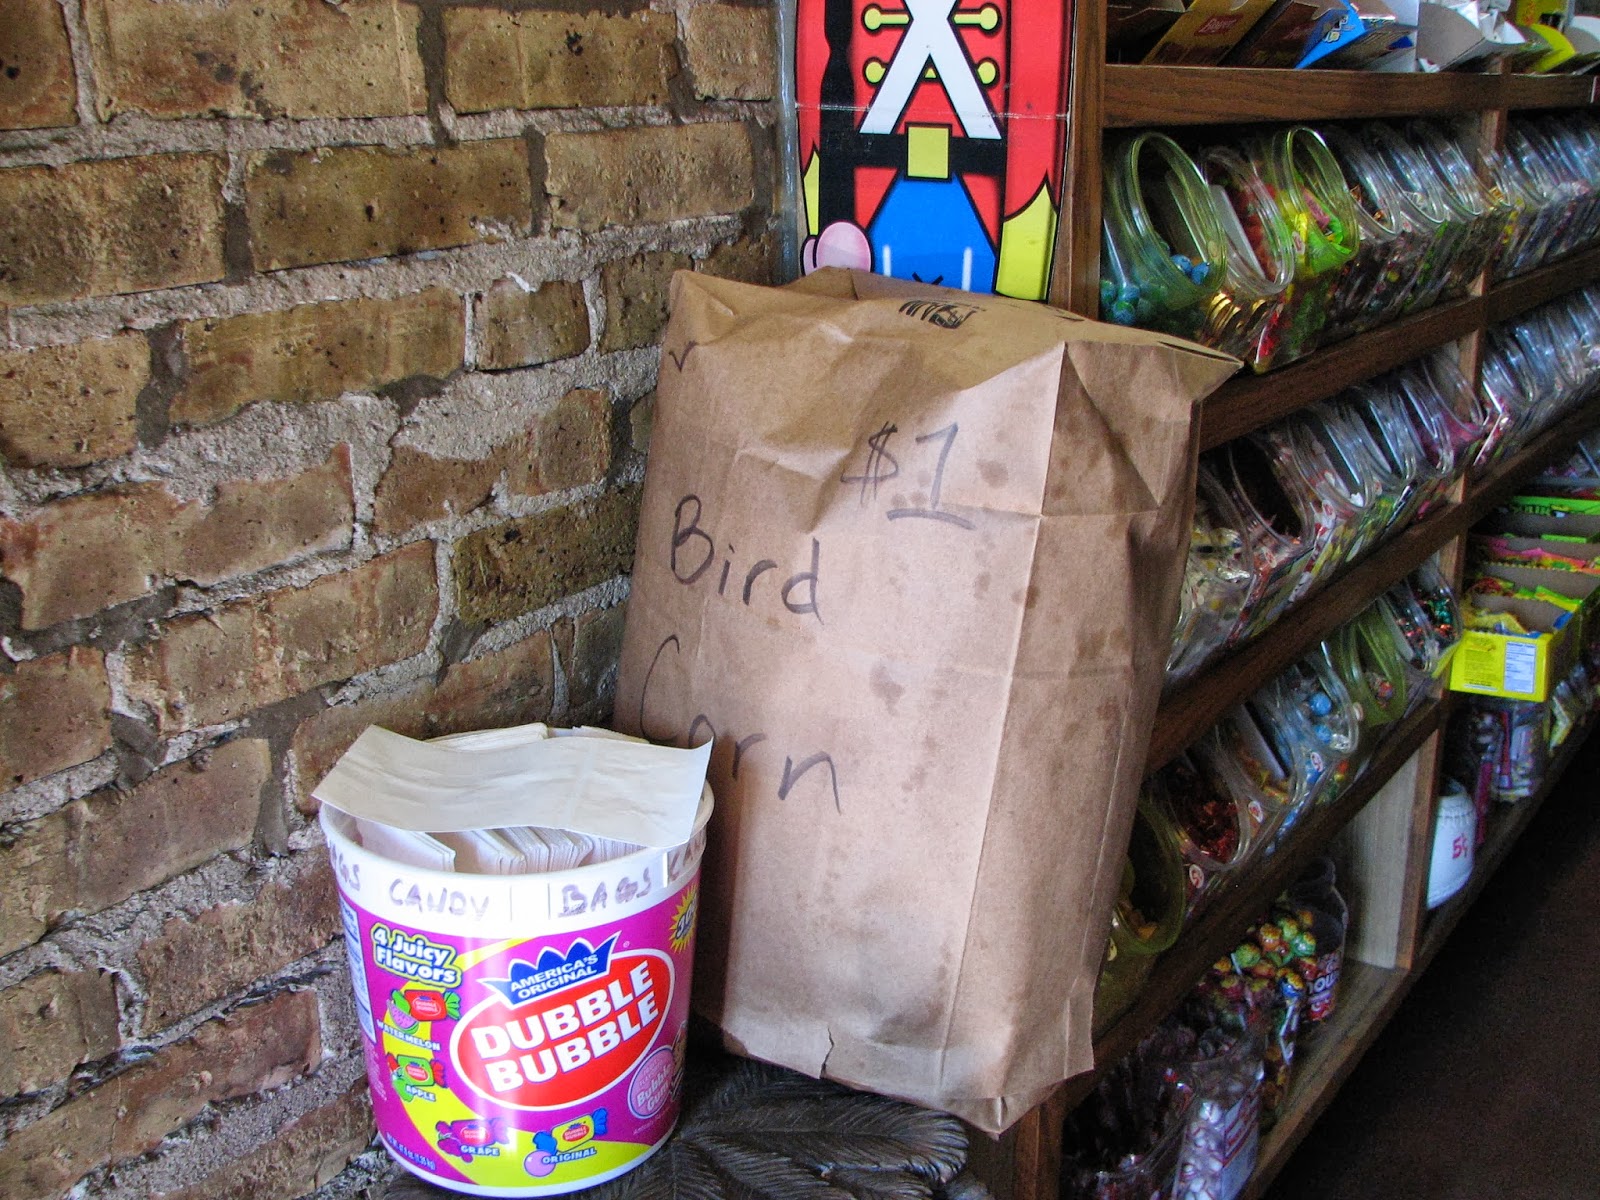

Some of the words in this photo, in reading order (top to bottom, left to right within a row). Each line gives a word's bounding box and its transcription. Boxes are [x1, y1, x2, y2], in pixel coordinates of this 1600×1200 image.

[669, 494, 824, 626] Bird
[557, 866, 652, 918] BAGS
[373, 927, 388, 945] 4
[392, 933, 451, 967] Juicy
[375, 945, 457, 984] Flavors
[510, 953, 599, 992] AMERICA'S
[517, 965, 598, 1000] ORIGINAL
[470, 959, 654, 1060] DUBBLE
[376, 1018, 441, 1052] WATERMELON
[484, 990, 660, 1093] BUBBLE
[405, 1085, 436, 1102] APPLE
[460, 1145, 500, 1157] GRAPE
[541, 1146, 598, 1165] ORIGINAL
